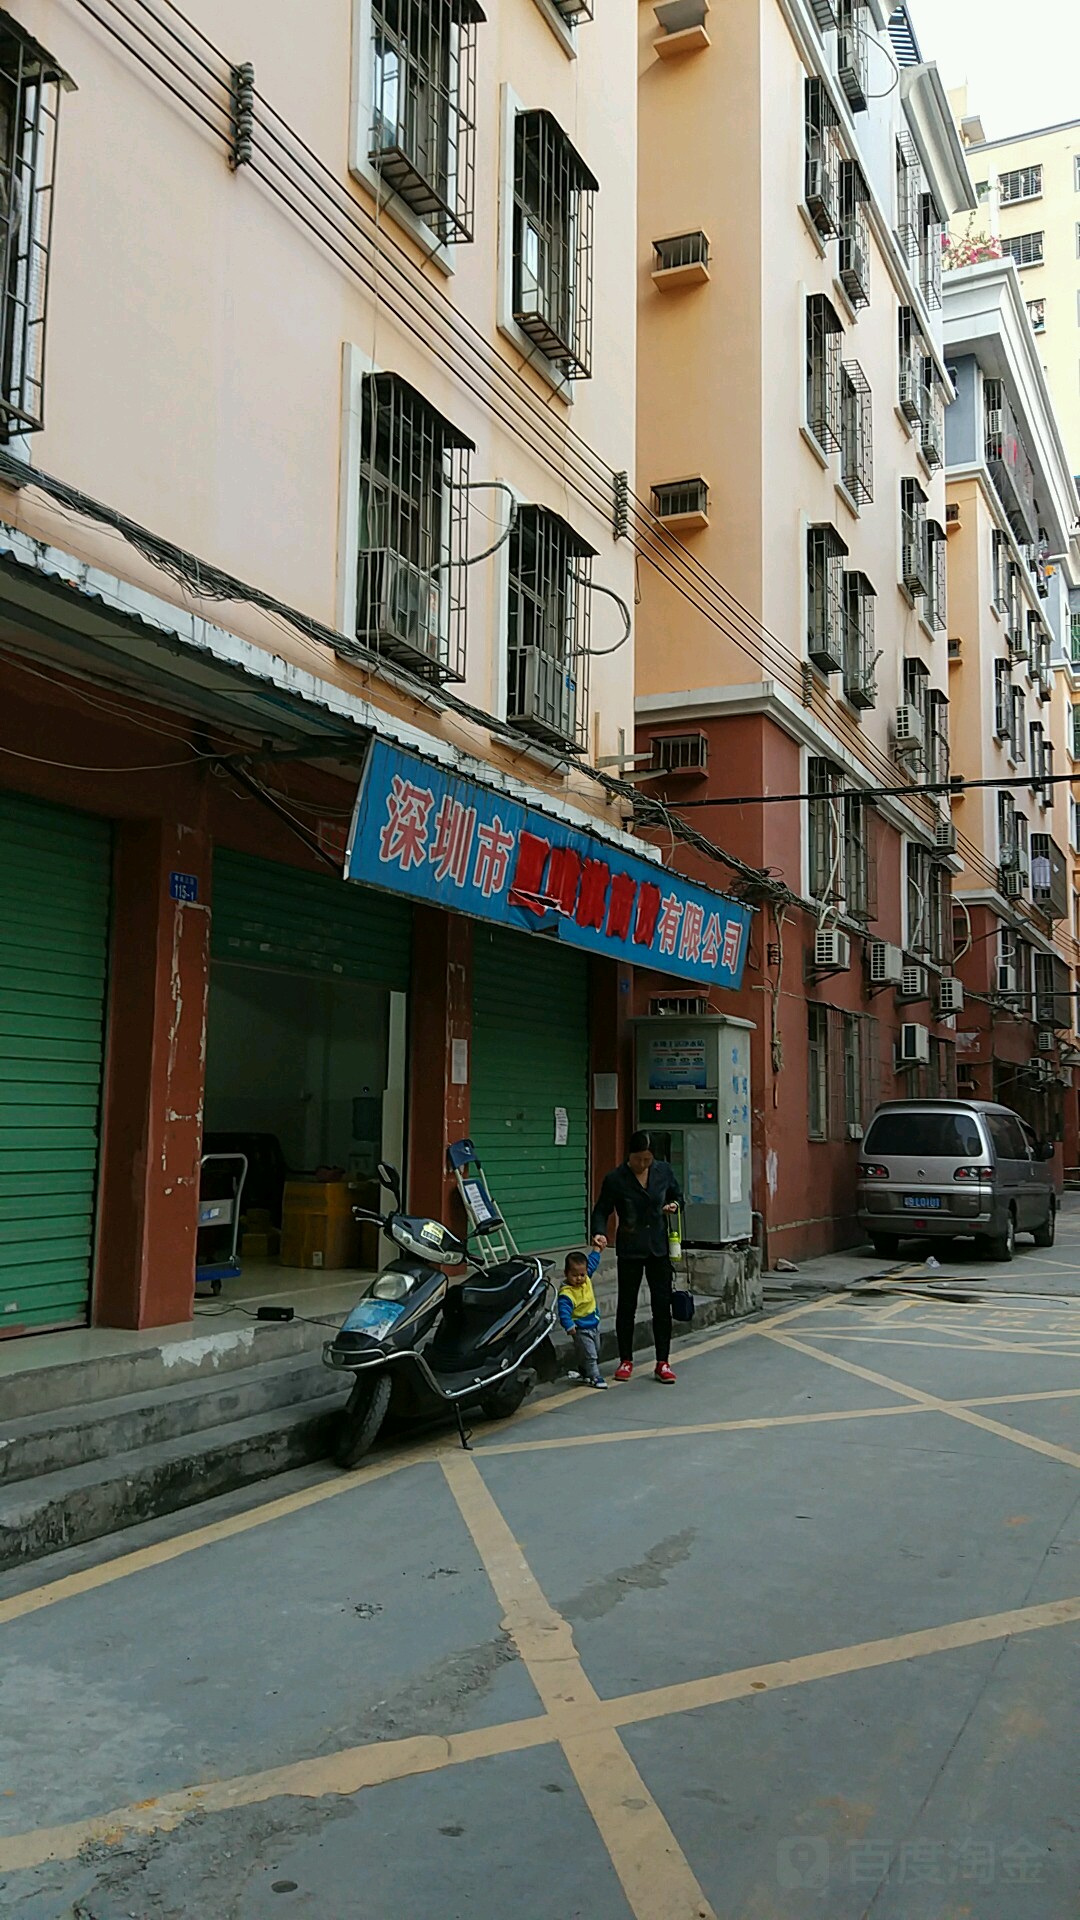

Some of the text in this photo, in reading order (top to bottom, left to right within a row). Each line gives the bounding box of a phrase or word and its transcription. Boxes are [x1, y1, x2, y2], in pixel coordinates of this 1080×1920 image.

[174, 884, 194, 901] 115-1
[379, 774, 743, 975] 深圳市有限公司
